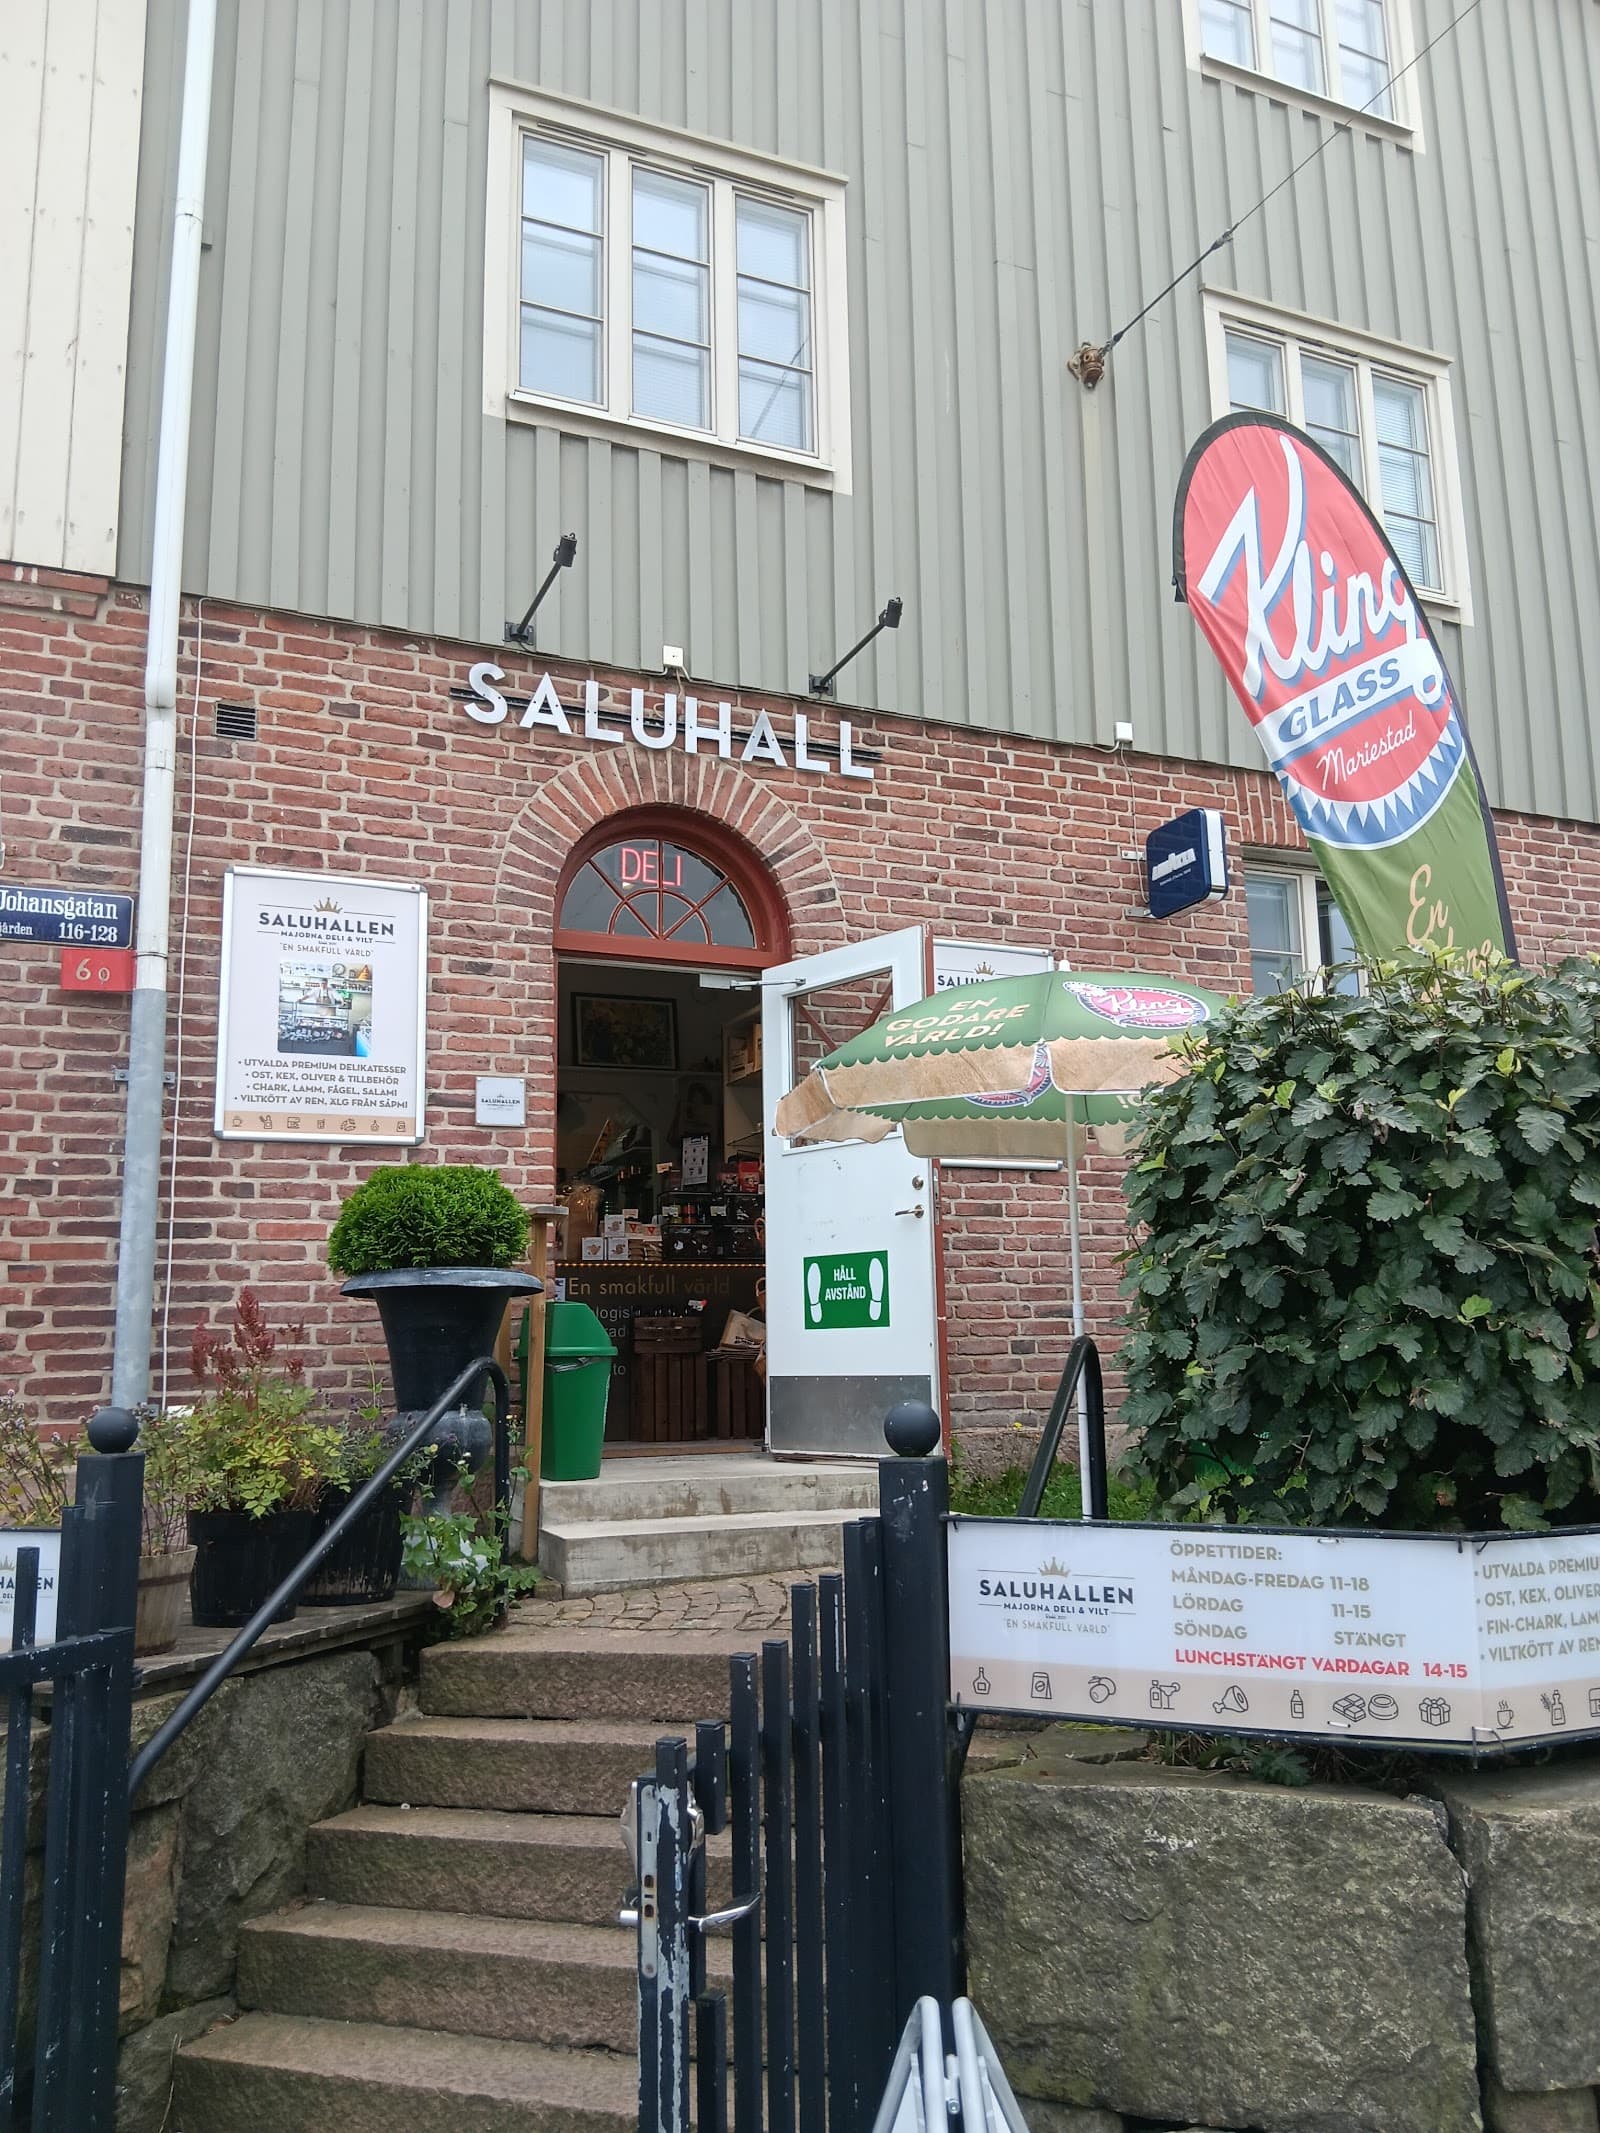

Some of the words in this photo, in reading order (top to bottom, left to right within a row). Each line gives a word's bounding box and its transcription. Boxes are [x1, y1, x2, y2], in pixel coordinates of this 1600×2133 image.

[1197, 435, 1430, 703] Kling
[1278, 658, 1400, 743] GLASS
[463, 662, 874, 779] SALUHALL
[1316, 710, 1416, 791] Mariestad
[0, 889, 118, 920] Johansgatan
[1406, 864, 1449, 945] En
[58, 922, 118, 942] 116-128
[259, 912, 394, 936] SALUHALLEN
[281, 931, 322, 940] MAJORNA
[297, 944, 342, 955] SMAKFULL
[948, 997, 999, 1011] EN
[886, 1003, 1031, 1032] GODARE
[885, 1022, 1005, 1048] VÄRLD!
[244, 1059, 289, 1068] UTVALDA
[292, 1061, 337, 1070] PREMIUM
[340, 1063, 407, 1074] DELIKATESSER
[301, 1073, 336, 1082] OLIVER
[348, 1075, 399, 1085] TILLBEHÖR
[241, 1094, 287, 1104] VILTKÖTT
[352, 1098, 377, 1107] FRÅN
[363, 1087, 397, 1097] SALAMI
[833, 1264, 856, 1281] HÅLL
[568, 1277, 591, 1295] En
[599, 1275, 675, 1295] smakfull
[684, 1275, 730, 1295] värld
[825, 1283, 866, 1301] AVSTÅND
[1170, 1539, 1283, 1561] ÖPPETTIDER:
[1171, 1567, 1324, 1589] MÅNDAG-FREDAG
[1330, 1576, 1370, 1591] 11-18
[1482, 1561, 1545, 1580] UTVALDA
[1549, 1556, 1600, 1574] PREMIU
[979, 1580, 1134, 1604] SALUHALLEN
[1484, 1591, 1515, 1607] OST,
[1519, 1587, 1551, 1604] KEX,
[1554, 1583, 1600, 1601] OLIVER
[1003, 1602, 1050, 1612] MAJORNA
[1054, 1606, 1075, 1614] DELI
[1078, 1606, 1085, 1614] &
[1088, 1607, 1109, 1616] VILT
[1172, 1593, 1244, 1613] LÖRDAG
[1332, 1603, 1372, 1619] 11-15
[1023, 1619, 1072, 1632] SMAKFULL
[1174, 1620, 1248, 1640] SÖNDAG
[1334, 1631, 1407, 1647] STÄNGT
[1486, 1613, 1567, 1635] FIN-CHARK,
[1571, 1609, 1600, 1626] LAM
[1488, 1640, 1554, 1662] VILTKÖTT
[1558, 1640, 1574, 1655] AV
[1175, 1649, 1306, 1671] LUNCHSTÄNGT
[1311, 1657, 1410, 1676] VARDAGAR
[1423, 1663, 1468, 1679] 14-15
